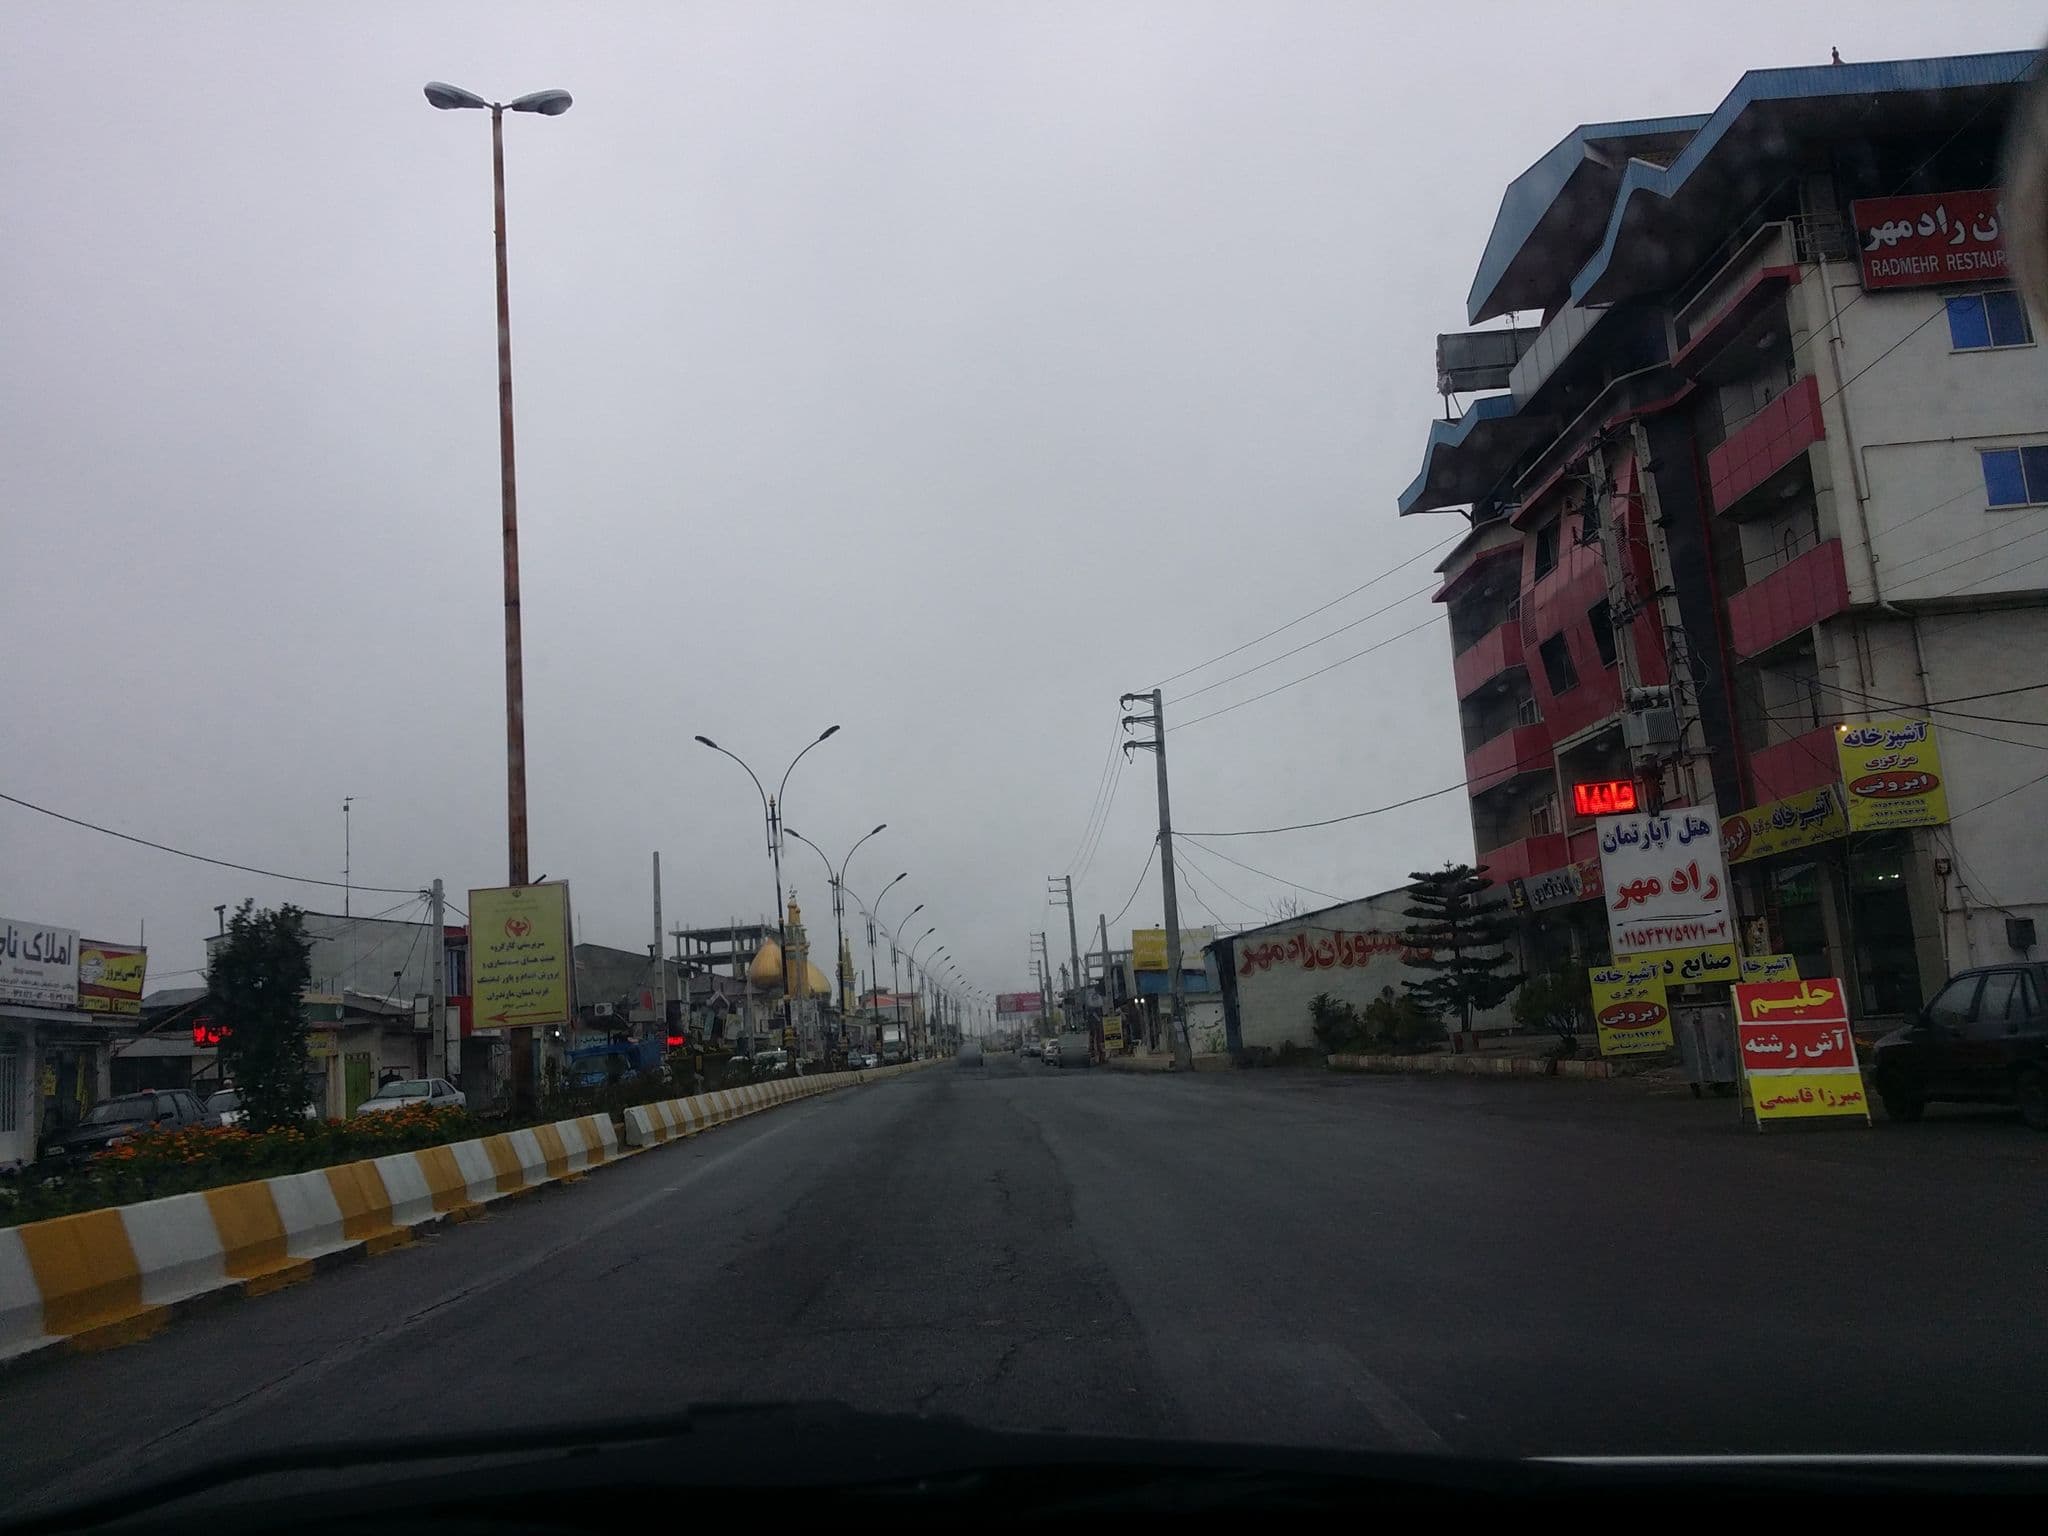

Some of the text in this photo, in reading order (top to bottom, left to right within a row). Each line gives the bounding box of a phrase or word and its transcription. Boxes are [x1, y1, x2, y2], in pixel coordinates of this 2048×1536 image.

[1871, 255, 1940, 277] RADMEHR
[1864, 754, 1919, 771] مرکزی
[1855, 774, 1929, 795] ایرونی
[1603, 816, 1711, 853] هتل آپارتمان
[23, 931, 72, 966] املاک
[1680, 951, 1732, 979] صنایع
[1610, 987, 1648, 1000] مرکزی
[1750, 982, 1835, 1019] حلیم
[1602, 1005, 1660, 1025] ایرونی
[1744, 1028, 1847, 1059] آش رشته
[1760, 1088, 1862, 1111] میرزا قاسمی
